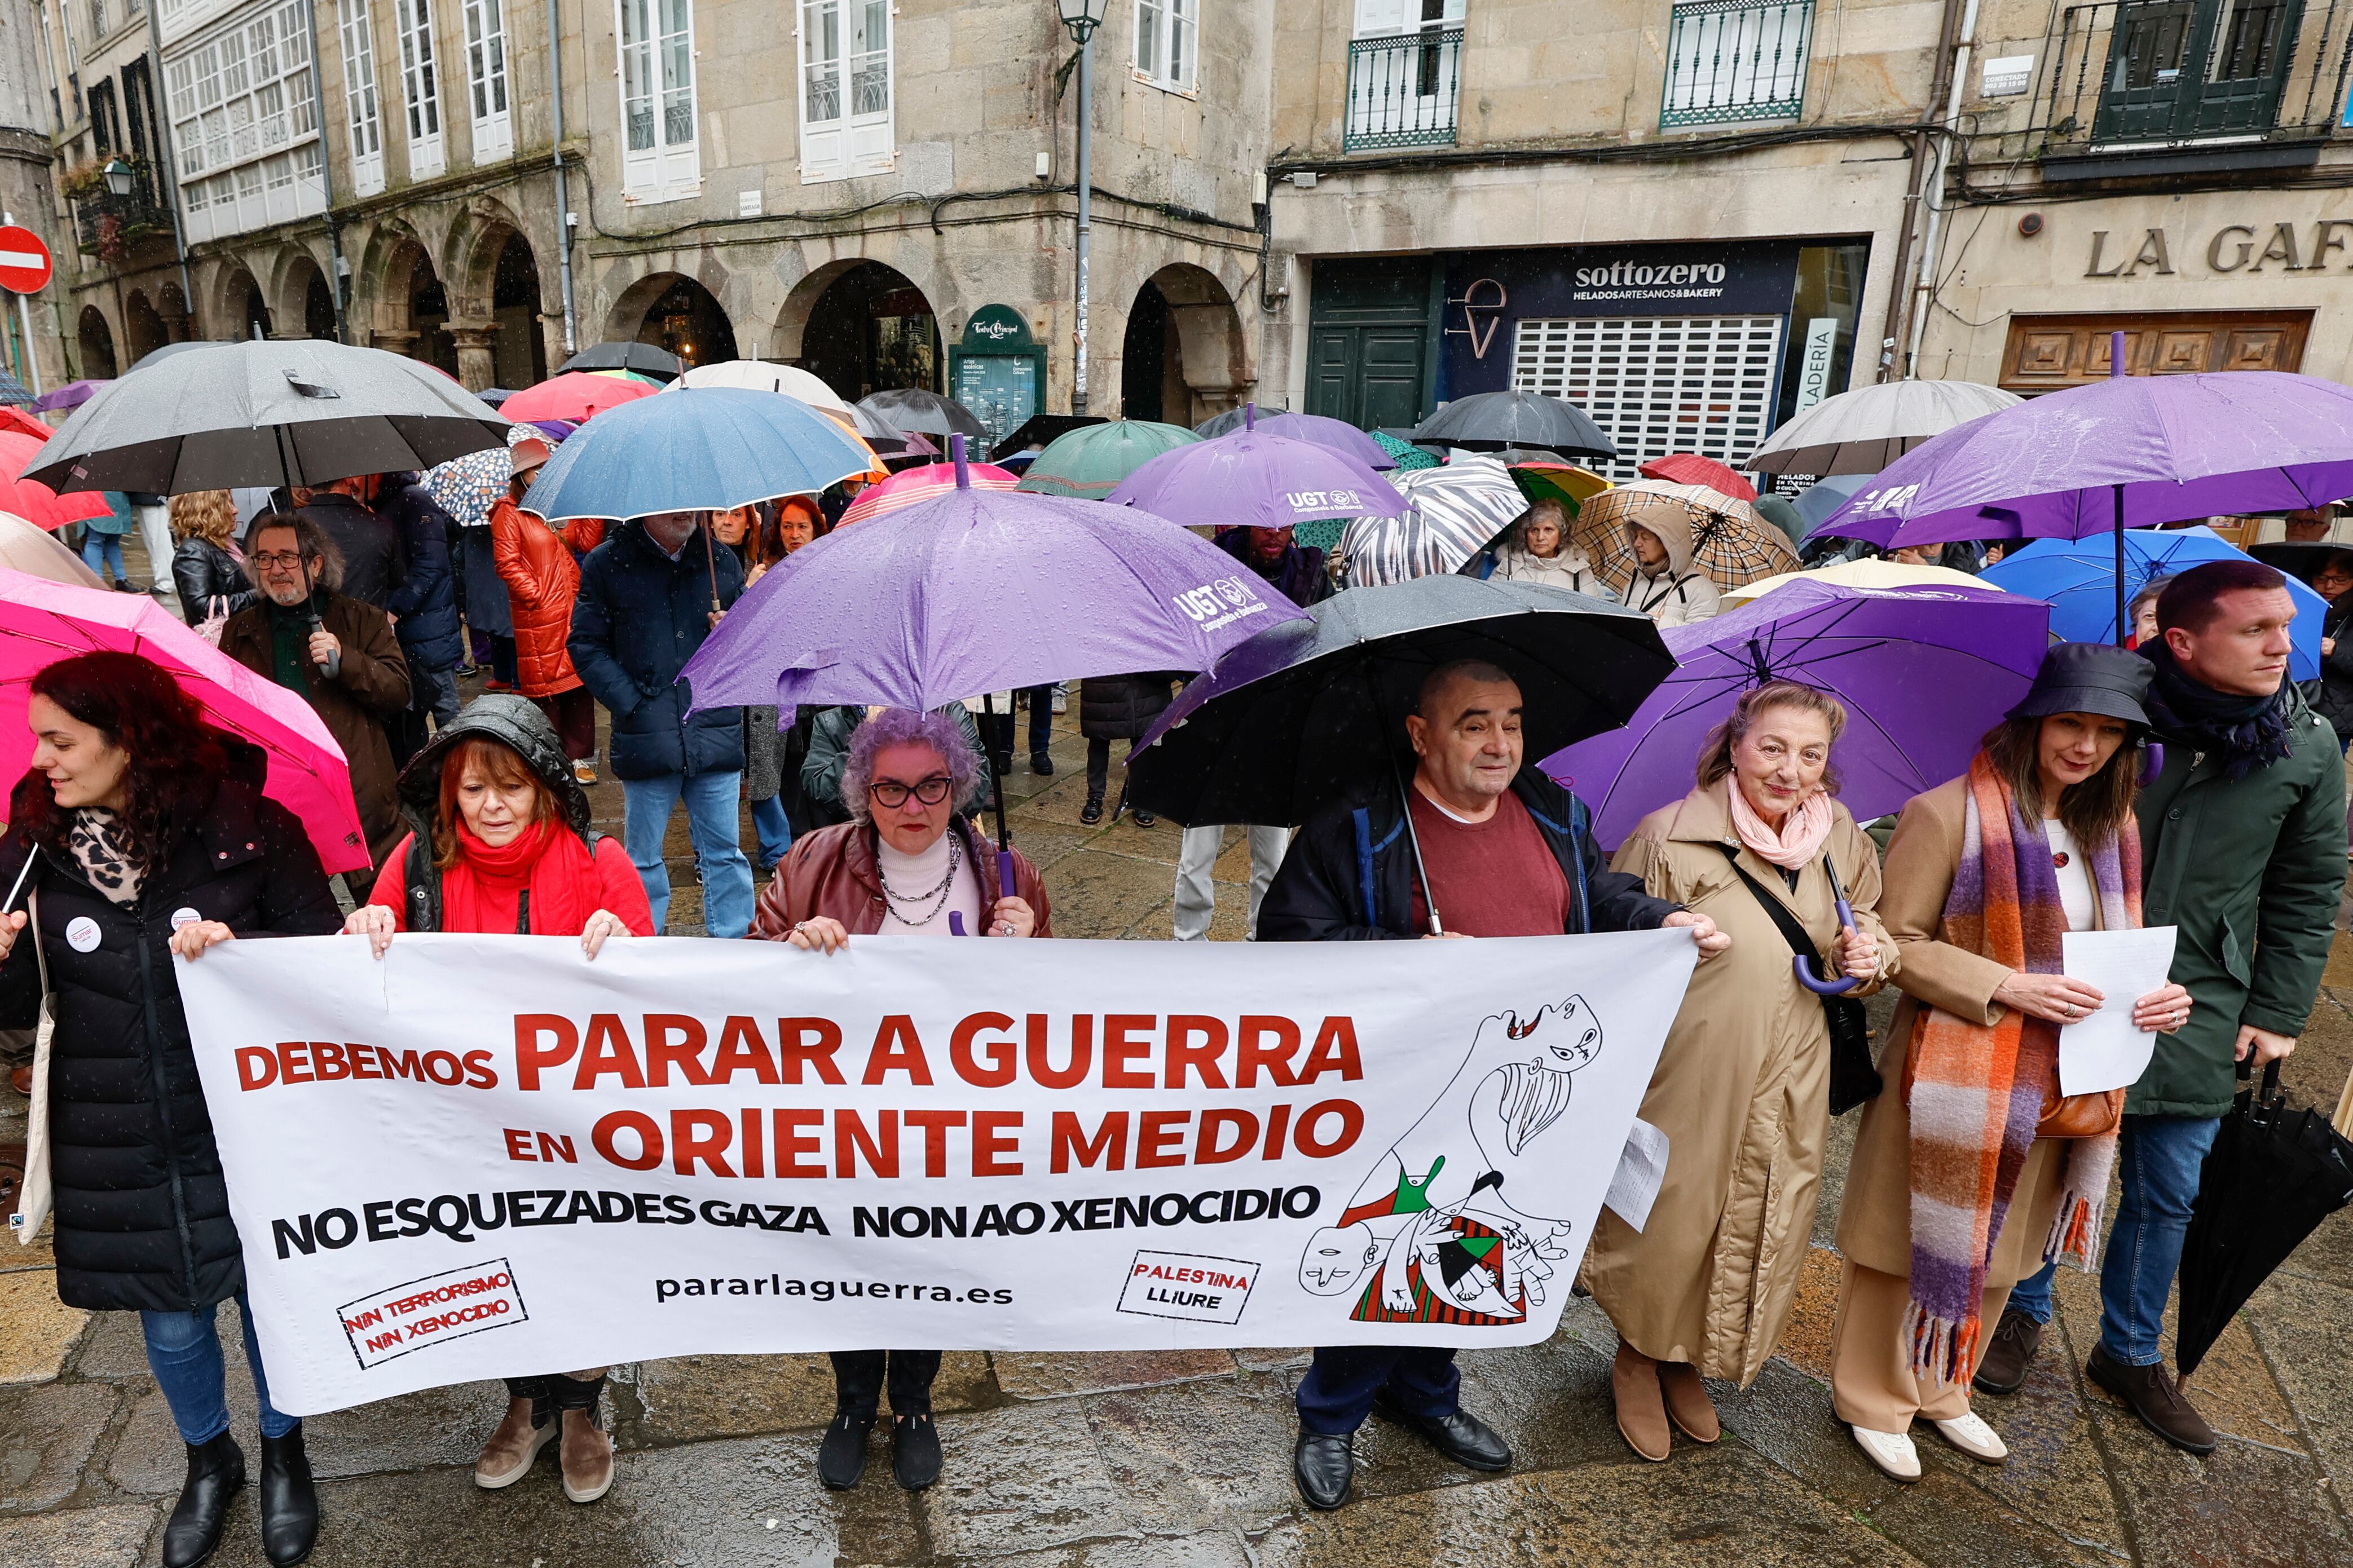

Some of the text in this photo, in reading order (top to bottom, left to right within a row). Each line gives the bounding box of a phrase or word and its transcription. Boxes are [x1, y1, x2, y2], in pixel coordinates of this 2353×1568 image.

[1985, 73, 2028, 83] CONECTADO
[2083, 219, 2353, 277] LA GAF
[1575, 259, 1726, 288] sottozero
[990, 320, 1017, 339] Principal
[1803, 331, 1830, 411] LADERÍA
[1286, 491, 1328, 507] UGT
[1172, 585, 1228, 621] UGT
[1200, 612, 1237, 633] Compostela
[72, 927, 92, 942] Sumar
[234, 1011, 1364, 1092] DEBEMOS PARAR A GUERRA
[503, 1099, 1364, 1178] EN ORIENTE MEDIO
[271, 1185, 1321, 1260] NO ESQUEZADES GAZA NON AO XENOCIDIO
[655, 1274, 1014, 1305] pararlaguerra.es
[1134, 1263, 1248, 1291] PALESTINA
[344, 1272, 510, 1334] NIN TERRORISMO
[1146, 1287, 1223, 1309] LLIURE
[365, 1298, 510, 1353] NIN XENOCIDIO
